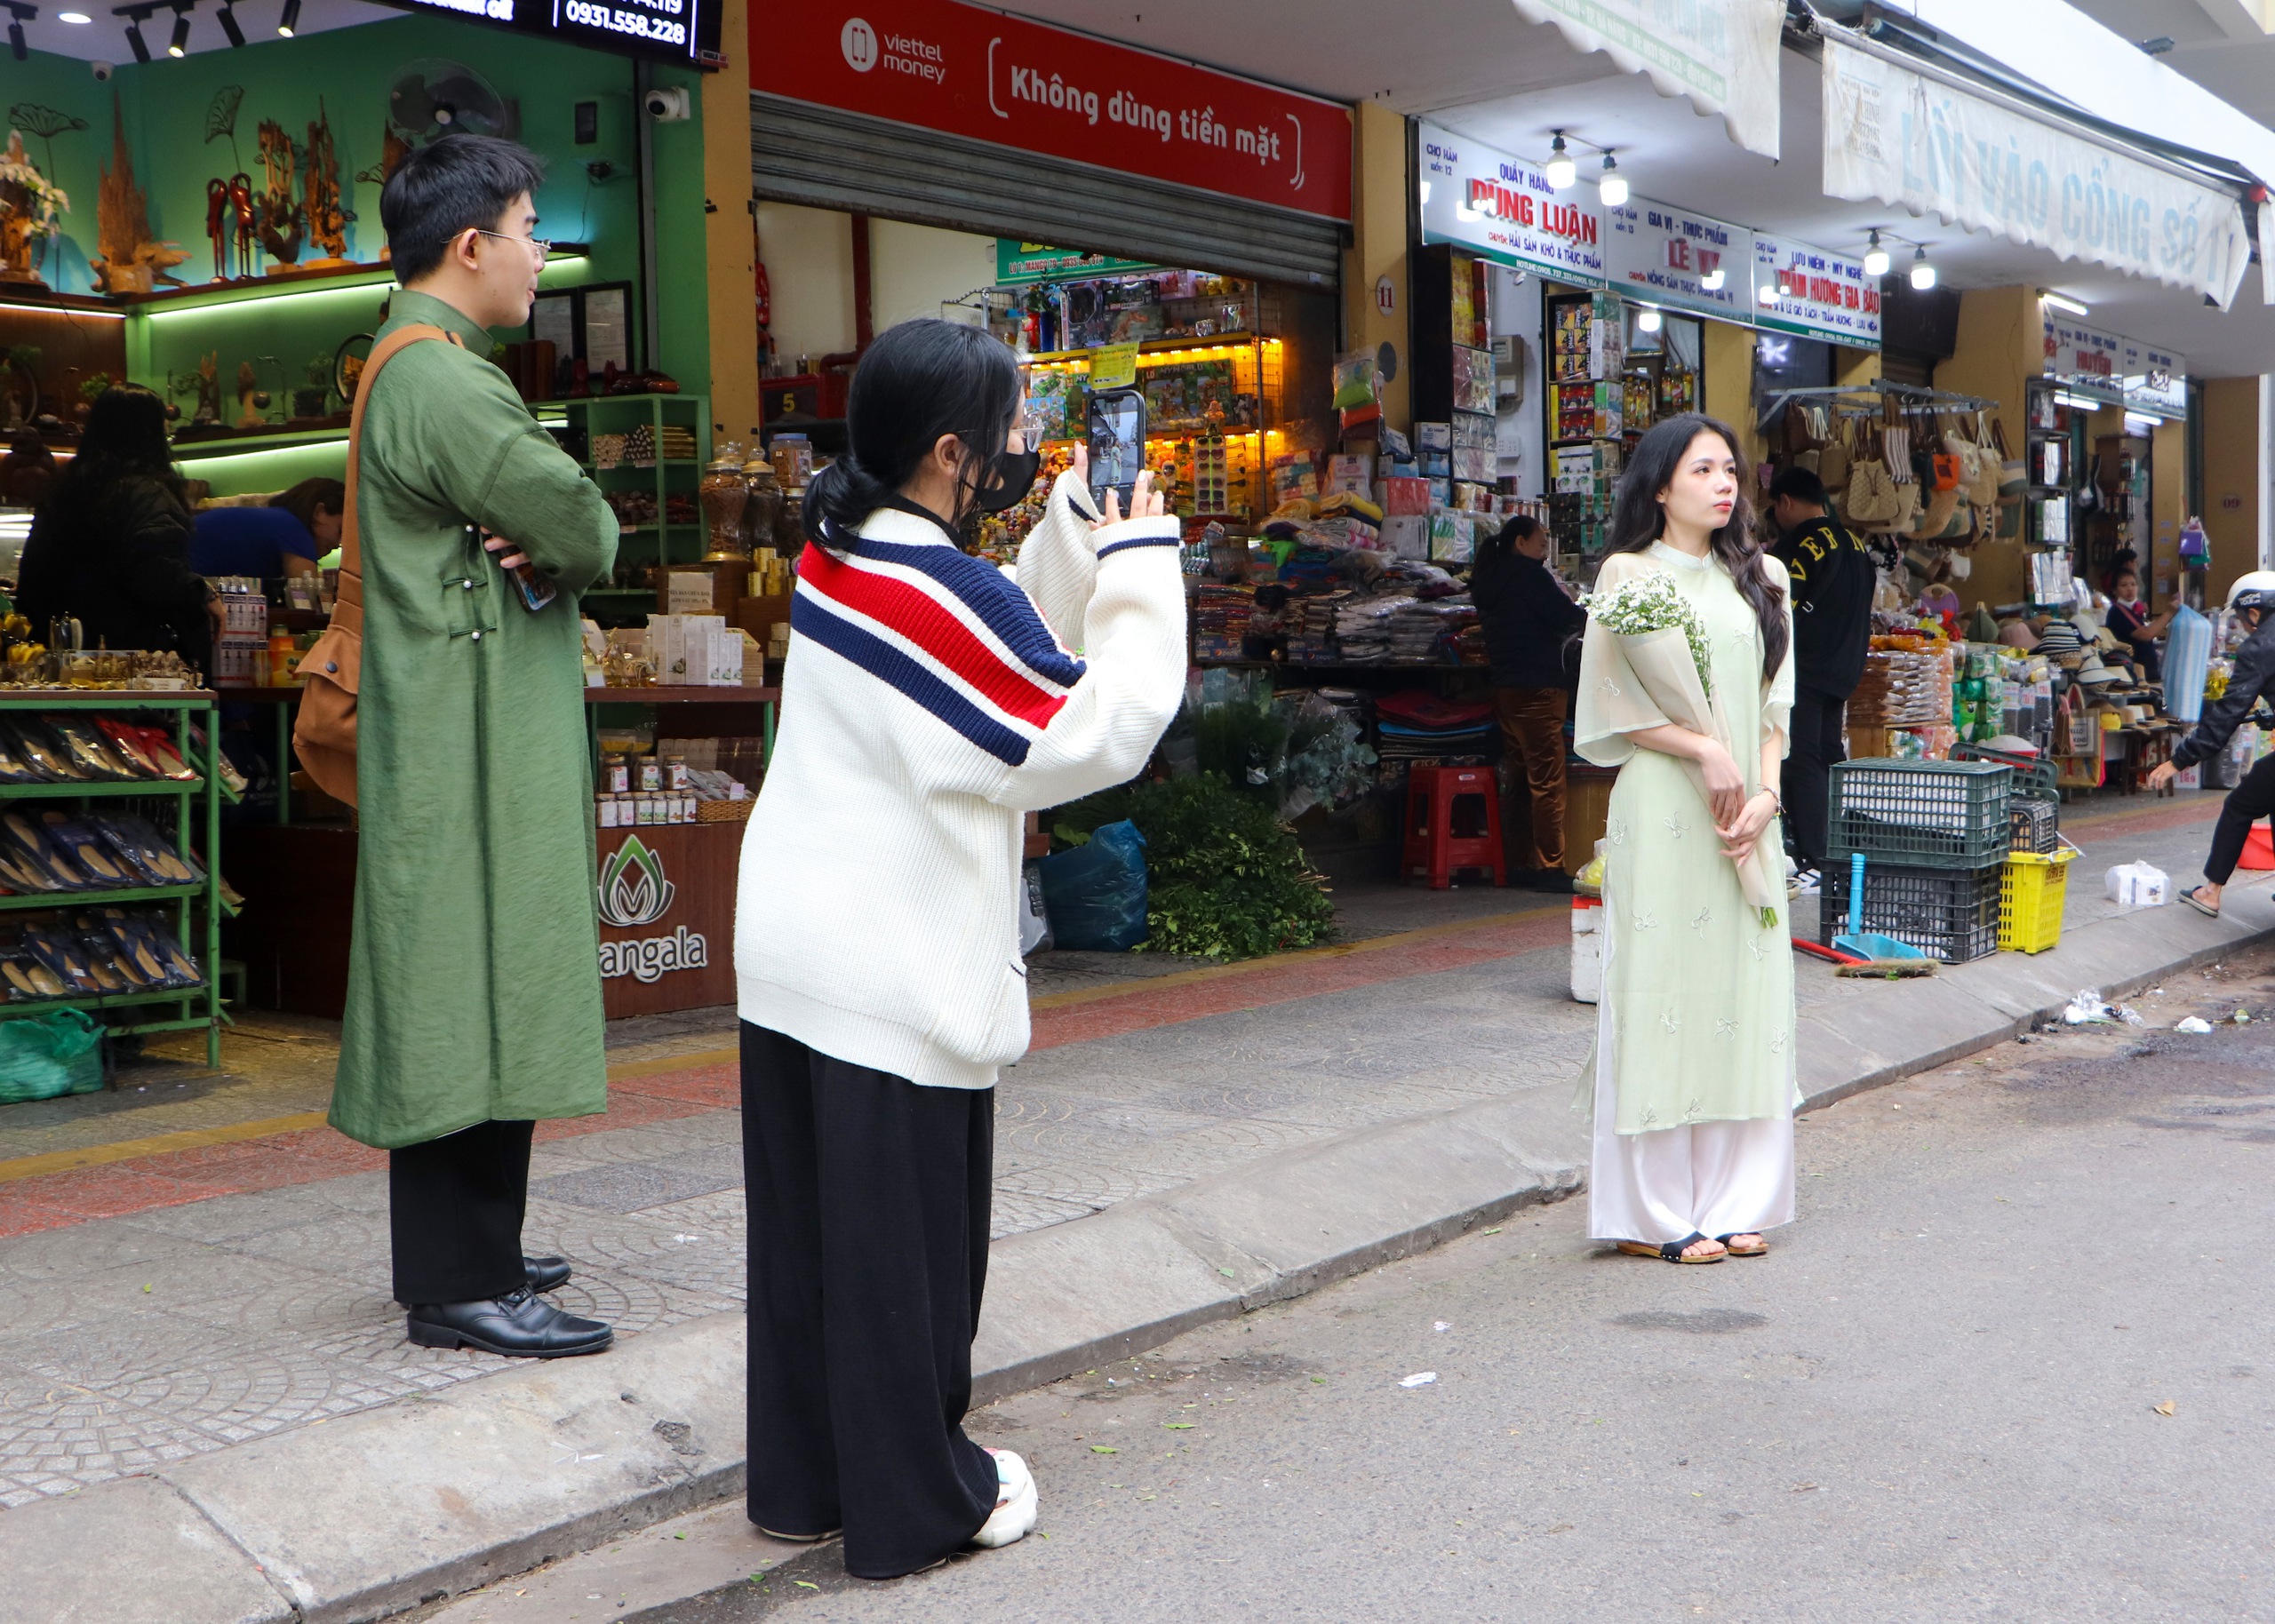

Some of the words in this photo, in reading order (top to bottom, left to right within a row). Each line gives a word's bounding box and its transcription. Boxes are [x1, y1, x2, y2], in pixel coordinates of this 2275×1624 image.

[566, 0, 686, 44] 0931.558.228
[883, 34, 943, 62] viettel
[883, 54, 946, 84] money
[1010, 65, 1098, 126] Không
[1108, 91, 1171, 142] dùng
[1179, 105, 1227, 149] tiền
[1235, 125, 1281, 167] mặt
[1443, 148, 1457, 163] HÀN
[1445, 164, 1452, 176] 12
[1499, 161, 1524, 185] QUẦY
[1529, 172, 1554, 195] HÀNG
[1901, 100, 1963, 206] LỐI
[1977, 134, 2048, 230] VÀO
[2062, 157, 2151, 263] CỔNG
[2160, 196, 2199, 276] SỐ
[1471, 177, 1534, 226] DŨNG
[1541, 203, 1597, 247] LUẬN
[1648, 211, 1662, 227] GIA
[1664, 216, 1672, 234] VỊ
[1540, 242, 1555, 259] KHÔ
[1557, 249, 1561, 259] &
[1025, 259, 1048, 272] MANGO
[1049, 259, 1058, 270] 79
[1378, 285, 1393, 306] 11
[1810, 275, 1841, 306] HƯƠNG
[1845, 284, 1859, 310] GIA
[1863, 283, 1880, 314] BẢO
[782, 393, 795, 412] 5
[598, 926, 707, 983] angala
